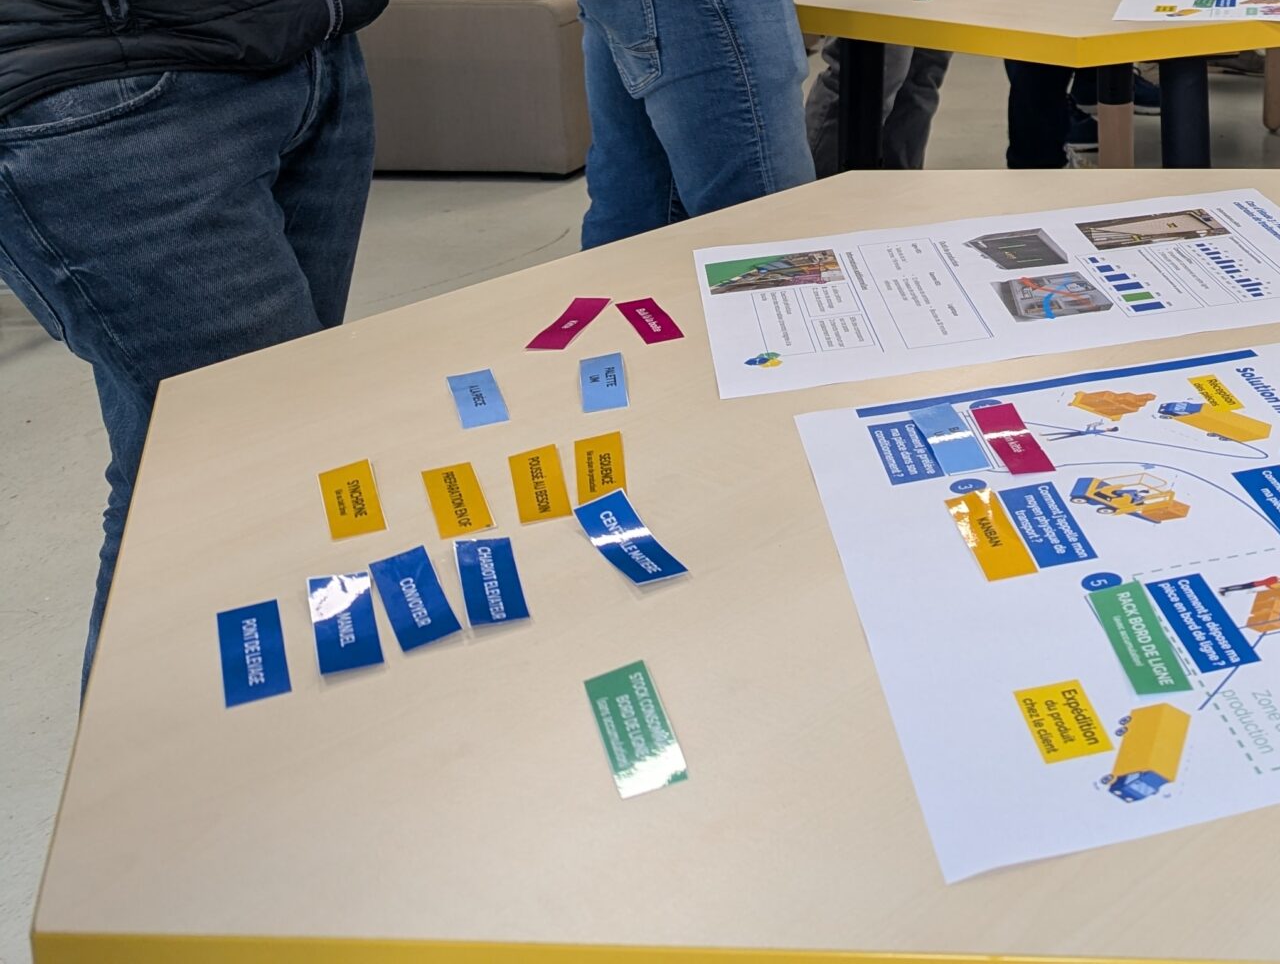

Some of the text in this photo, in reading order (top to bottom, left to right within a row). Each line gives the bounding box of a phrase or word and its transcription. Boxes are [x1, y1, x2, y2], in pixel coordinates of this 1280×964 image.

[604, 366, 616, 387] PALETTE
[1206, 378, 1236, 405] Réception
[1235, 367, 1280, 402] Solution
[874, 430, 901, 473] conditionnement
[890, 428, 917, 474] ma pièce dans son
[904, 423, 923, 446] Comment
[916, 453, 935, 474] prélève
[346, 479, 367, 517] SYNCHRONE
[443, 471, 472, 527] PREPARATION EN OF
[527, 456, 550, 513] POUSSÉ AU BESOIN
[1260, 487, 1273, 497] ma
[976, 516, 1002, 547] KANBAN
[1014, 509, 1039, 538] transport
[1024, 494, 1065, 553] moyen physique de
[1037, 485, 1087, 557] Comment j'appelle mon
[399, 577, 430, 626] CONVOYEUR
[477, 546, 506, 618] CHARIOT ELEVATEUR
[1090, 578, 1107, 586] 5
[335, 612, 354, 646] MANUEL
[1112, 615, 1143, 666] (avec accumulation)
[1116, 591, 1174, 685] RACK BORD DE LIGNE
[1157, 582, 1179, 602] pièce
[1173, 602, 1186, 612] en
[1180, 611, 1201, 630] bord
[1192, 630, 1205, 641] de
[1199, 640, 1219, 660] ligne
[1177, 579, 1240, 662] Comment je dépose ma
[242, 618, 264, 685] PONT DE LEVAGE
[629, 672, 649, 699] STOCK
[616, 694, 649, 758] BORD DE LIGNE
[1022, 697, 1058, 753] chez le client
[1044, 699, 1075, 743] du produit
[1061, 688, 1098, 745] Expédition
[1215, 689, 1273, 754] production
